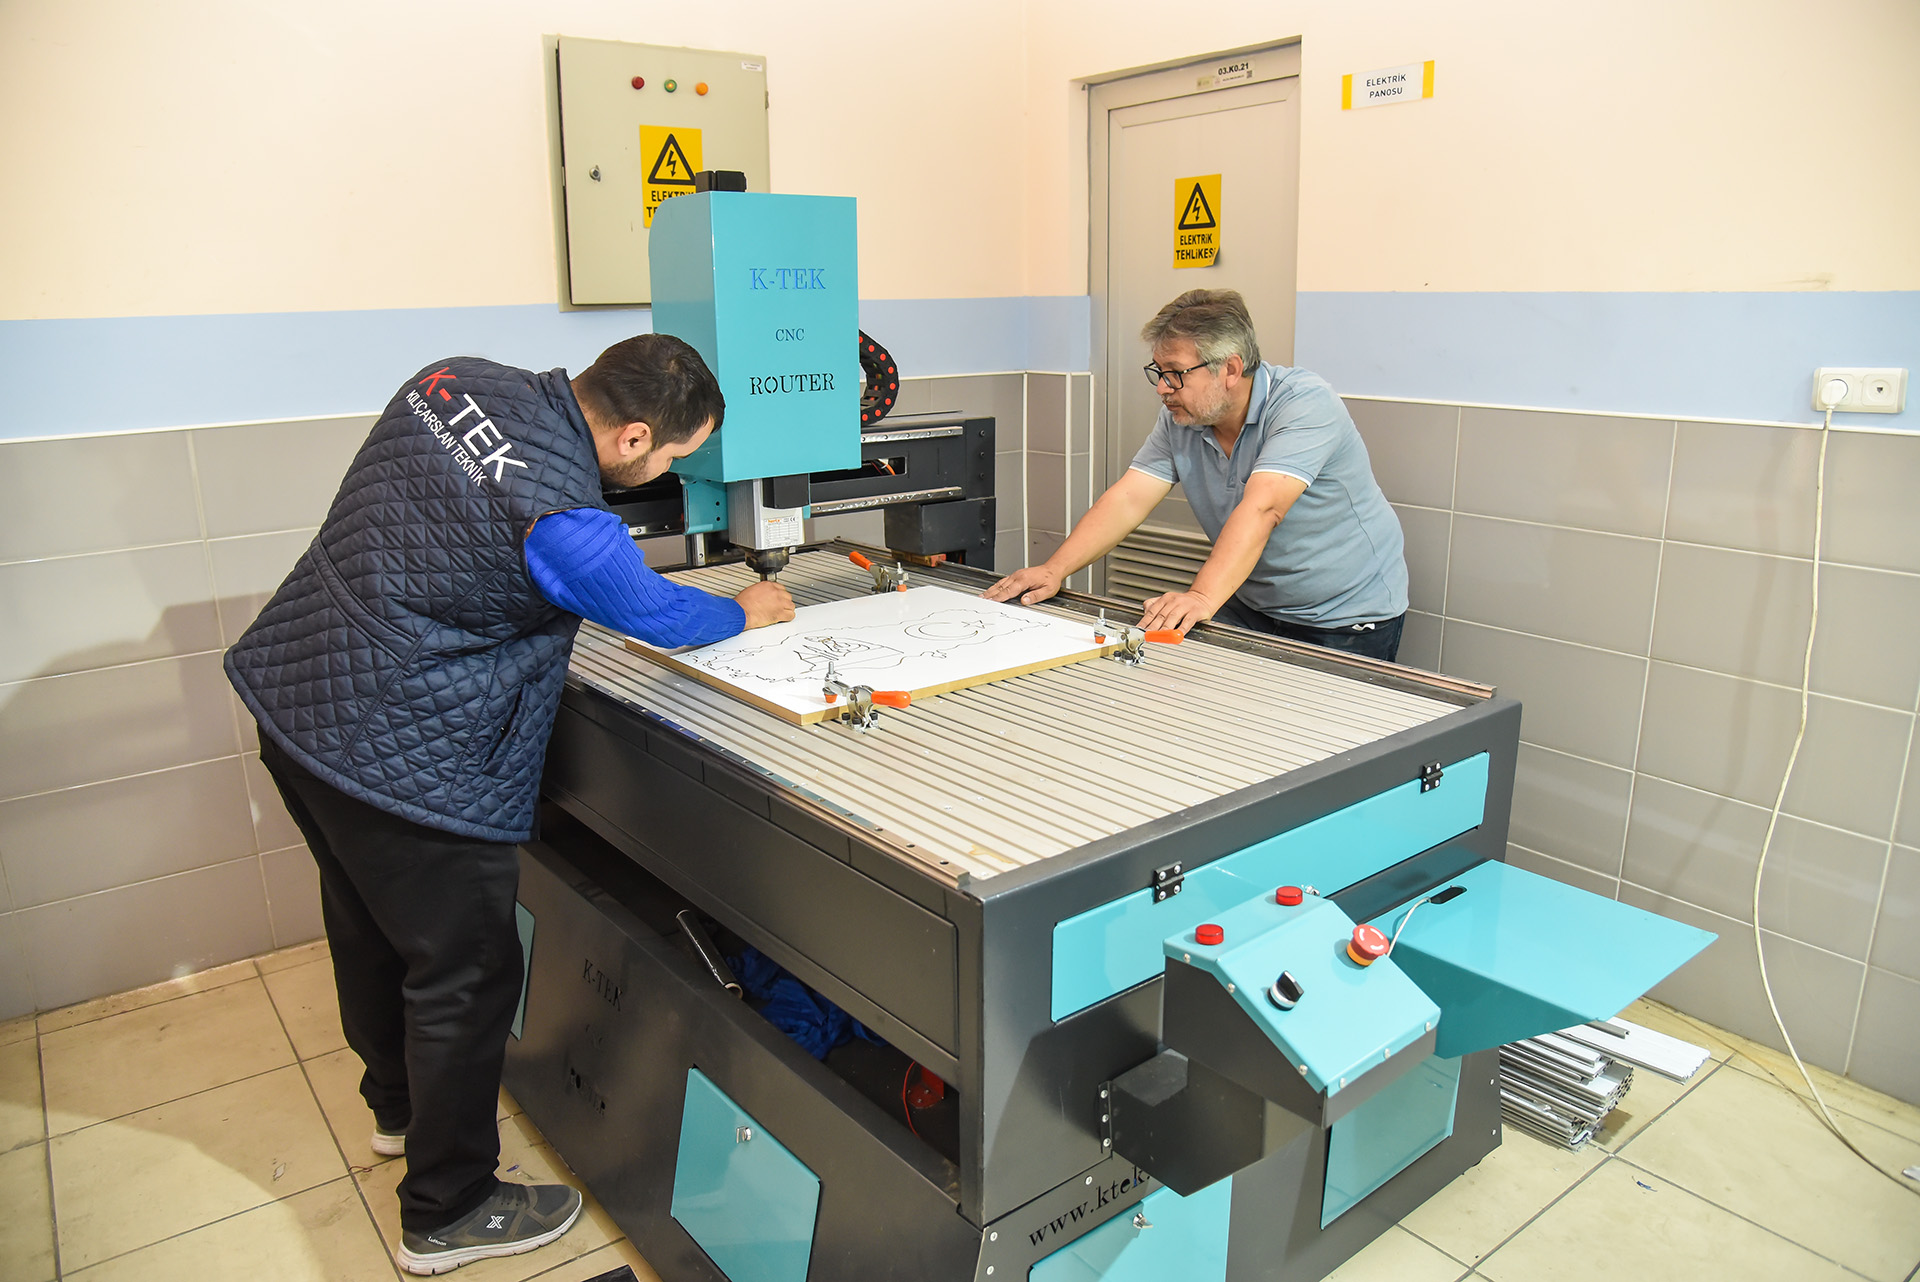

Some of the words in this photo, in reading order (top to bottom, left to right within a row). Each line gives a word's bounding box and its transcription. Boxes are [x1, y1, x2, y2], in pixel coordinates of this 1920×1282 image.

[1366, 73, 1407, 87] ELEKTRİK
[1369, 87, 1403, 98] PANOSU
[749, 268, 826, 290] K-TEK
[775, 328, 805, 341] CNC
[749, 373, 835, 395] ROUTER
[418, 366, 529, 483] K-TEK
[405, 389, 457, 449] KILIÇARSLAN
[450, 443, 488, 487] TEKNİK
[582, 958, 623, 1012] K-TEK
